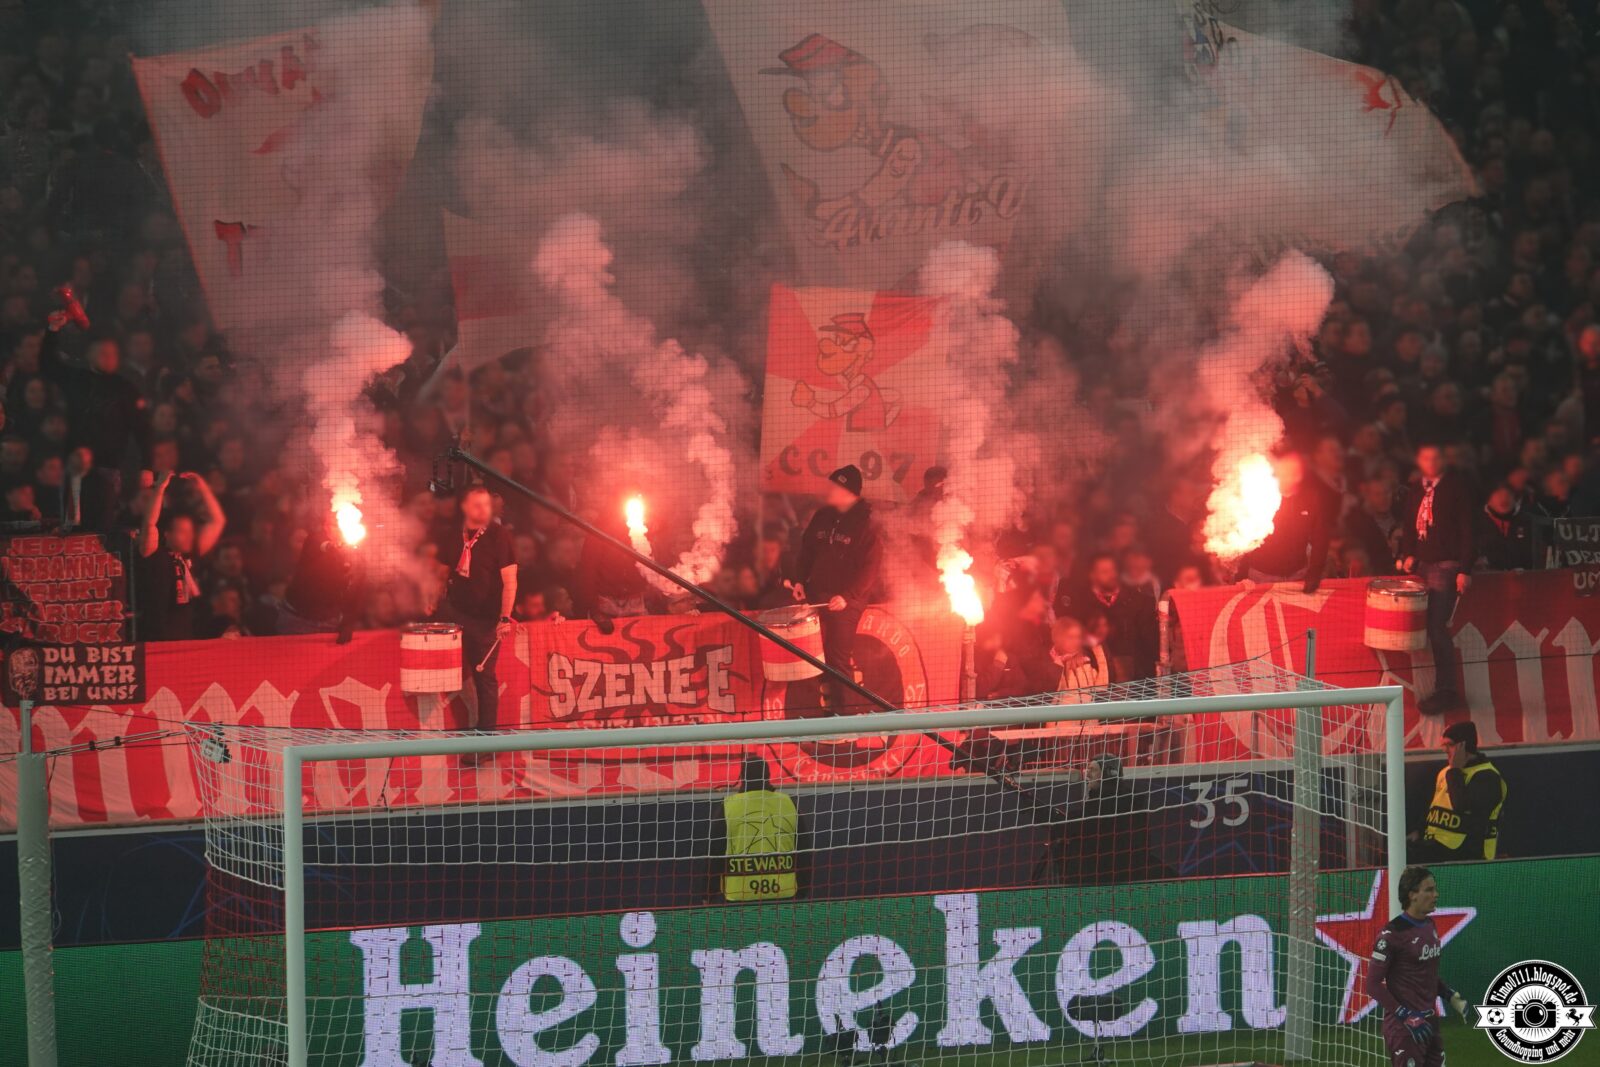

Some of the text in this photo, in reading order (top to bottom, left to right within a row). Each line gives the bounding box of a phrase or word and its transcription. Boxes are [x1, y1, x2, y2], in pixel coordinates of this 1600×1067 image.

[860, 450, 915, 484] 97
[43, 646, 136, 663] DU BIST
[44, 665, 136, 684] IMMER
[548, 645, 736, 719] SZENE E
[44, 684, 138, 700] BEI UNS!
[1190, 779, 1250, 829] 35
[729, 855, 793, 873] STEWARD
[749, 879, 780, 894] 986
[350, 892, 1288, 1067] Heineken
